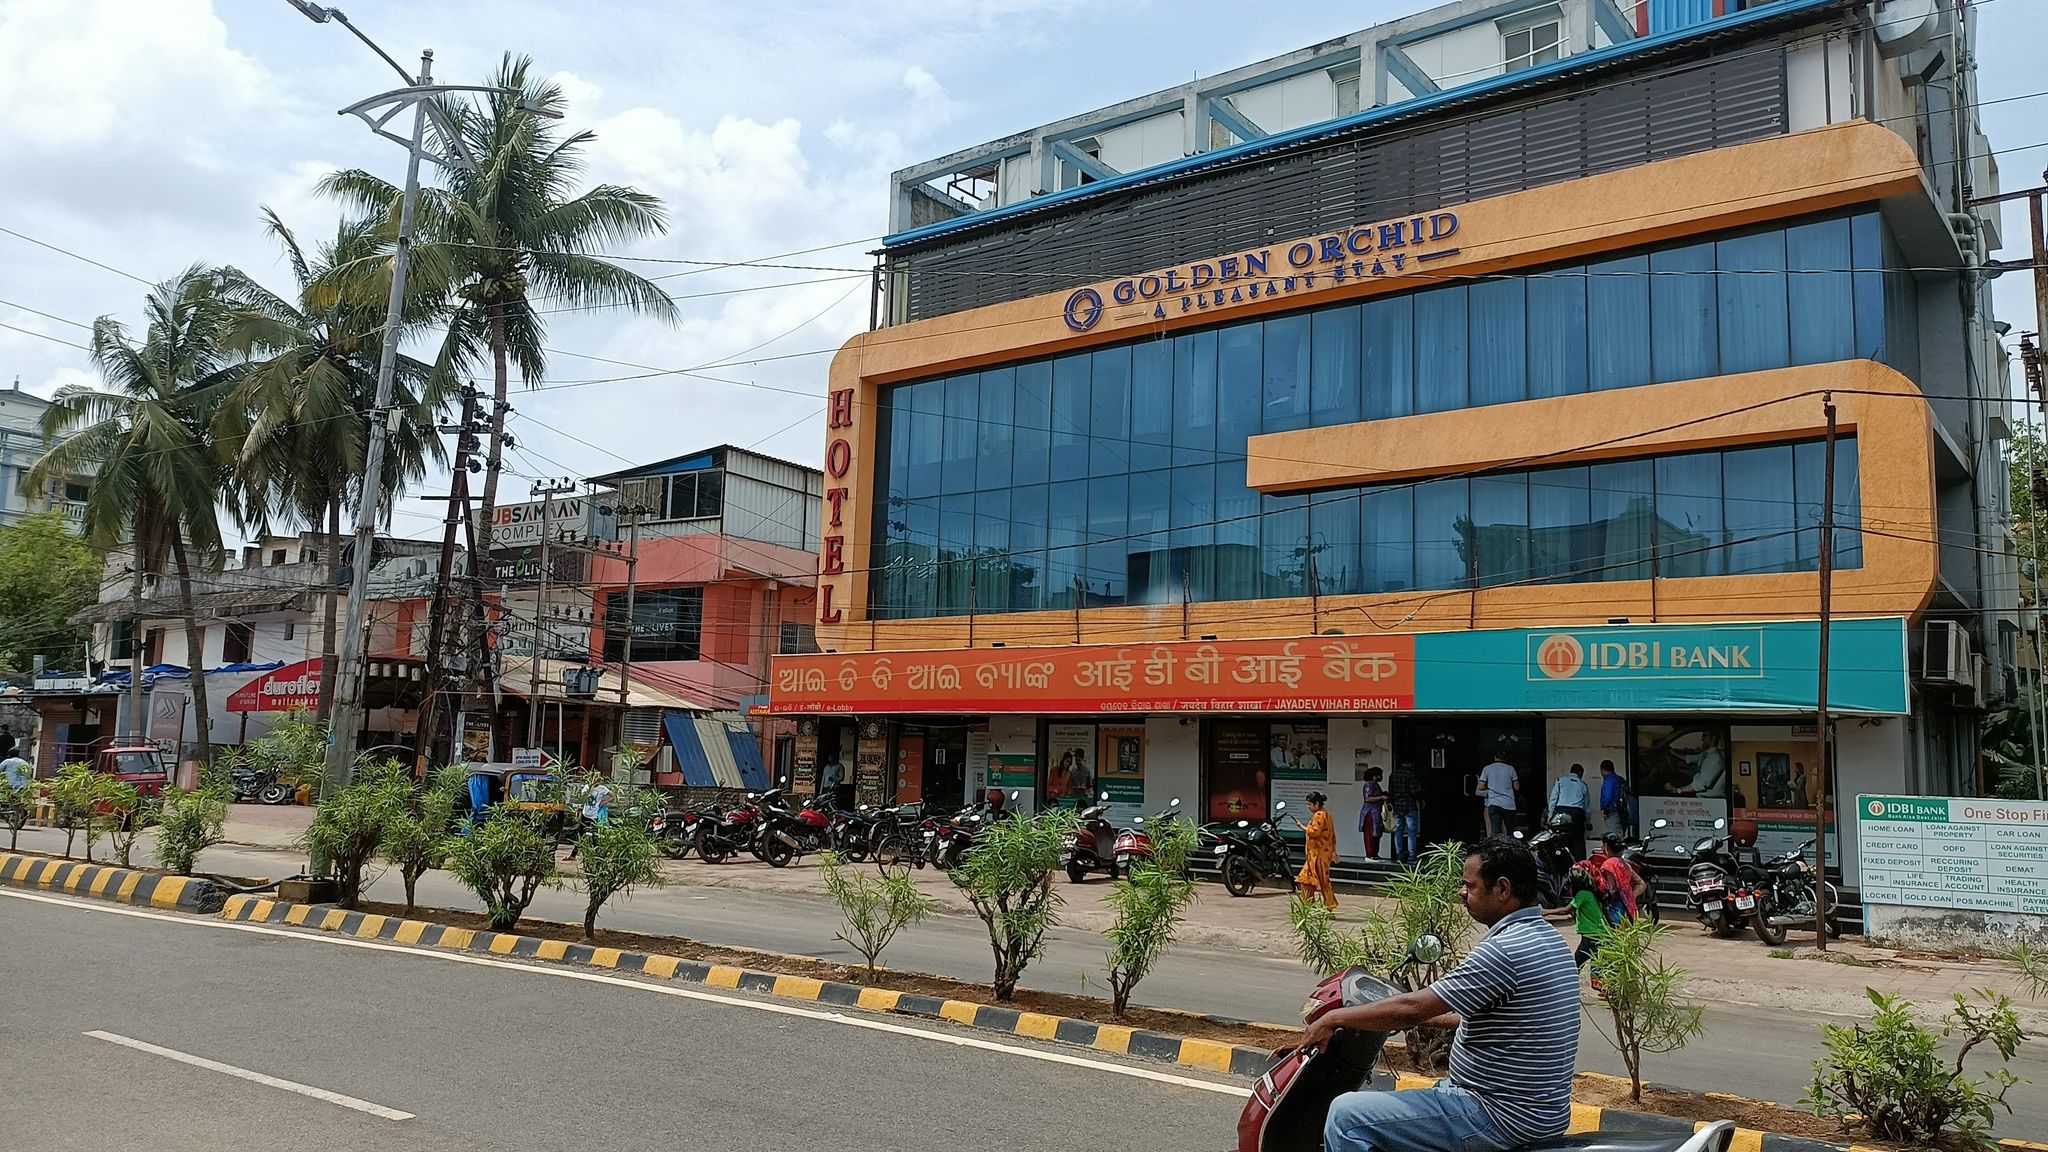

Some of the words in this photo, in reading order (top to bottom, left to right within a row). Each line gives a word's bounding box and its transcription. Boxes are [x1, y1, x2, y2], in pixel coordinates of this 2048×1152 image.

[1113, 250, 1270, 304] GOLDEN
[1288, 212, 1460, 268] ORCHID
[1153, 301, 1166, 319] A
[1181, 270, 1315, 312] PLEASANT
[1334, 252, 1406, 282] STAY
[820, 388, 854, 624] HOTEL
[491, 521, 565, 542] COMPLEX
[495, 565, 514, 578] THE
[516, 559, 554, 577] OLIVS
[1590, 641, 1661, 670] IDBI
[1671, 645, 1751, 669] BANK
[1073, 649, 1136, 691] आई
[1143, 647, 1178, 685] डी
[1184, 645, 1224, 684] बी
[1231, 642, 1306, 689] आई
[1320, 641, 1398, 682] बैंक
[264, 674, 321, 695] duroflex
[778, 666, 827, 693] ଆଇ
[907, 664, 964, 690] ଆଇ
[826, 703, 854, 712] e-Lobby
[1180, 698, 1207, 710] जयदेव
[1211, 698, 1234, 710] विहार
[1238, 700, 1262, 710] शाखा
[1274, 698, 1318, 710] JAYADEV
[1320, 698, 1350, 710] VIHAR
[1353, 698, 1398, 709] BRANCH
[1887, 803, 1914, 814] IDBI
[1917, 807, 1946, 816] BANK
[1964, 807, 1991, 819] One
[1996, 808, 2028, 823] Stop
[2033, 809, 2048, 821] Fi
[1931, 858, 1979, 866] RECCURING
[1997, 851, 2043, 859] SECURITIES
[1945, 875, 1982, 883] TRADING
[2004, 879, 2038, 887] HEALTH
[1865, 892, 1897, 900] LOCKER
[1997, 886, 2047, 895] INSURANCE
[1976, 899, 2014, 907] MACHINE
